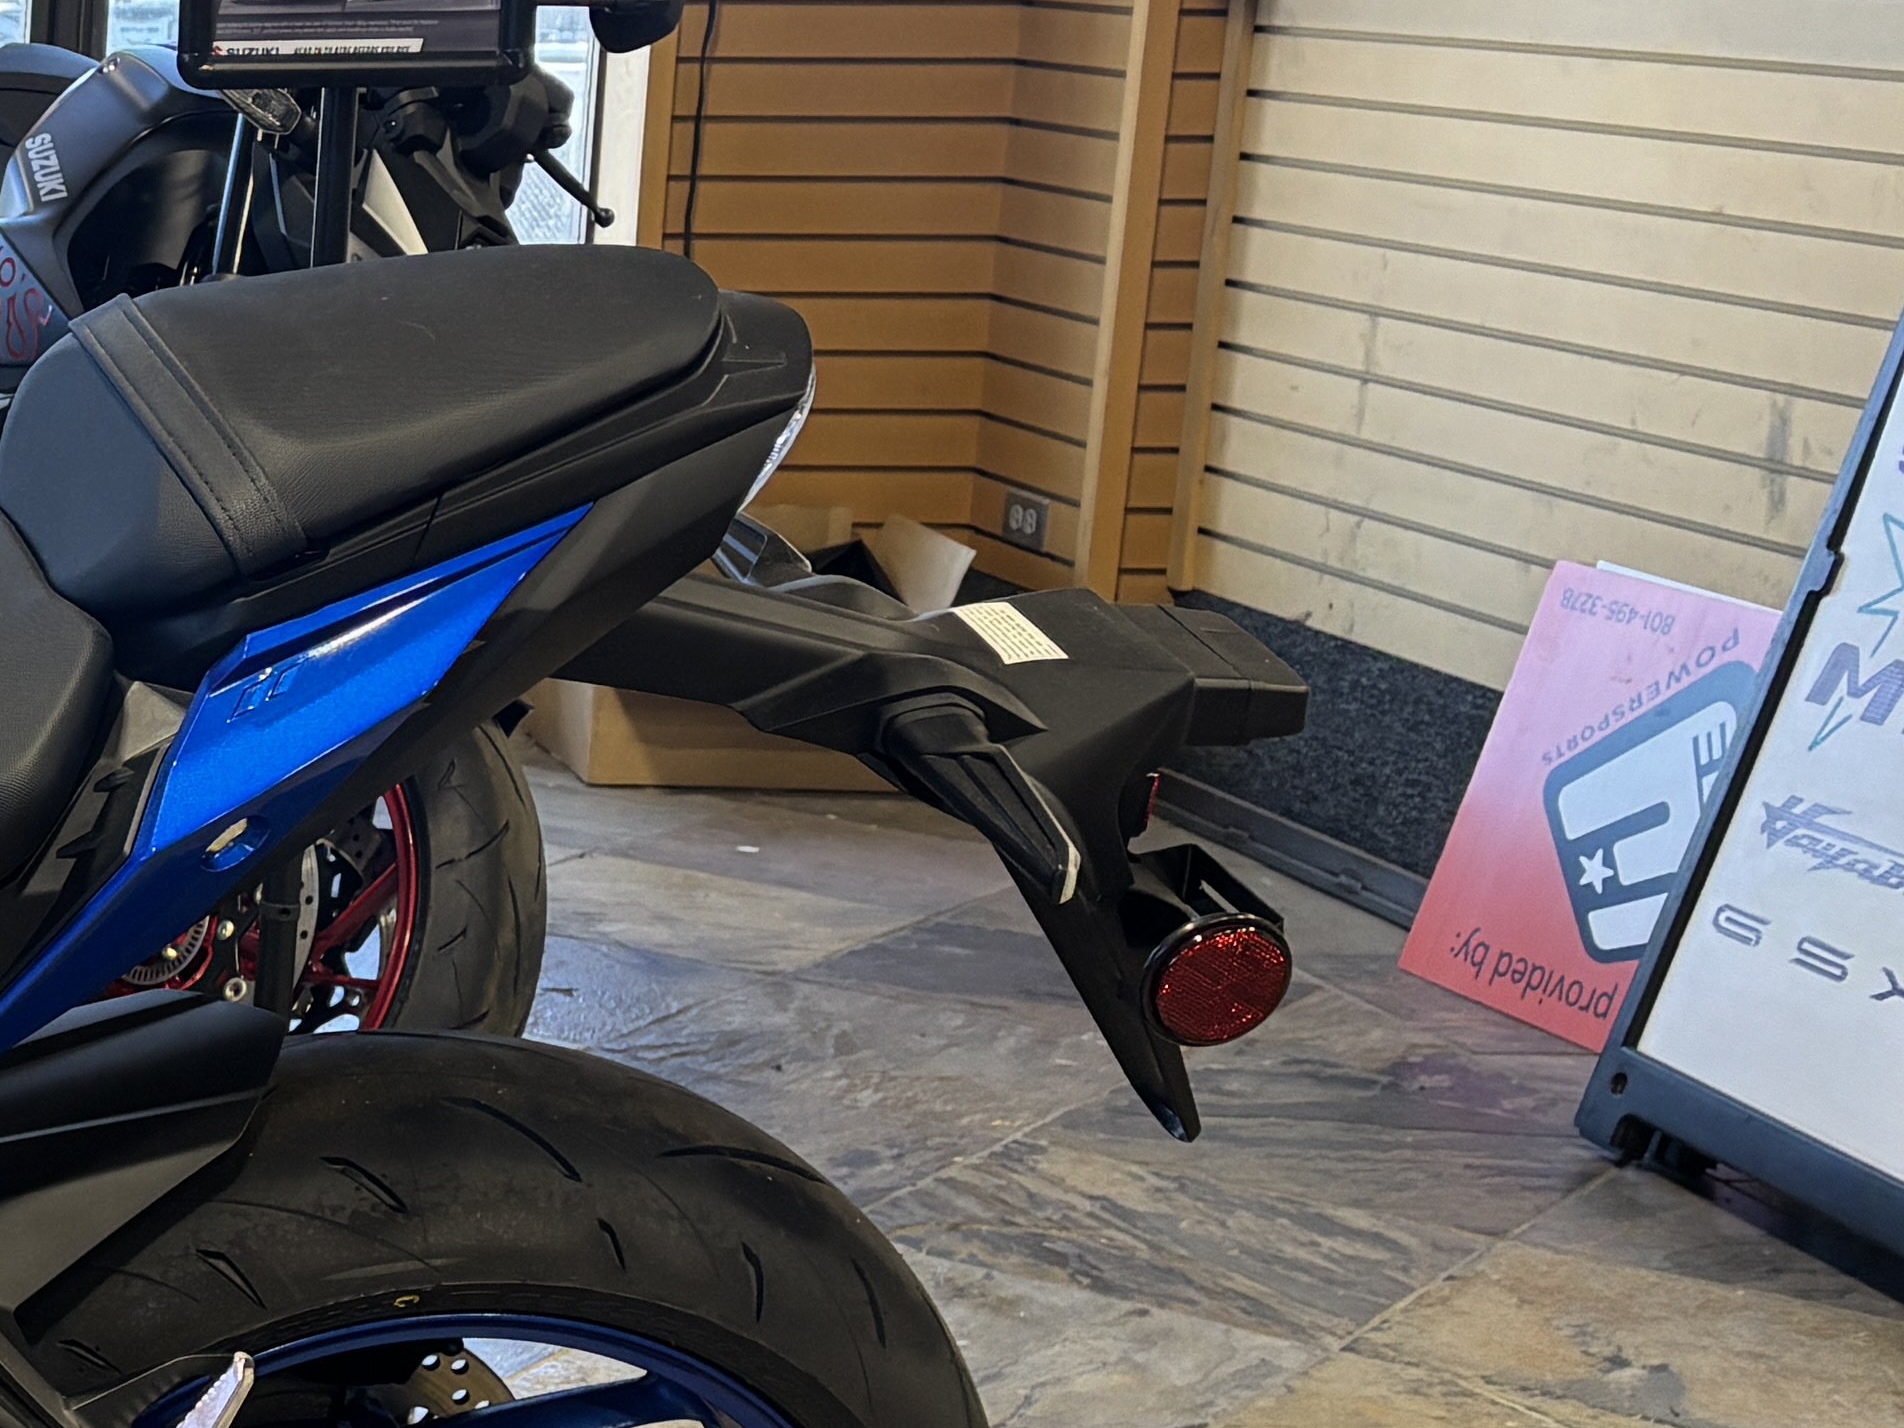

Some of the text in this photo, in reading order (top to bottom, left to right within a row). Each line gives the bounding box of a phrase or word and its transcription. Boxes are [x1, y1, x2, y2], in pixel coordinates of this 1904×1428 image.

[25, 132, 69, 203] SUZUKI
[1541, 627, 1741, 766] POWERSPORTS
[1450, 926, 1620, 1021] provided by:
